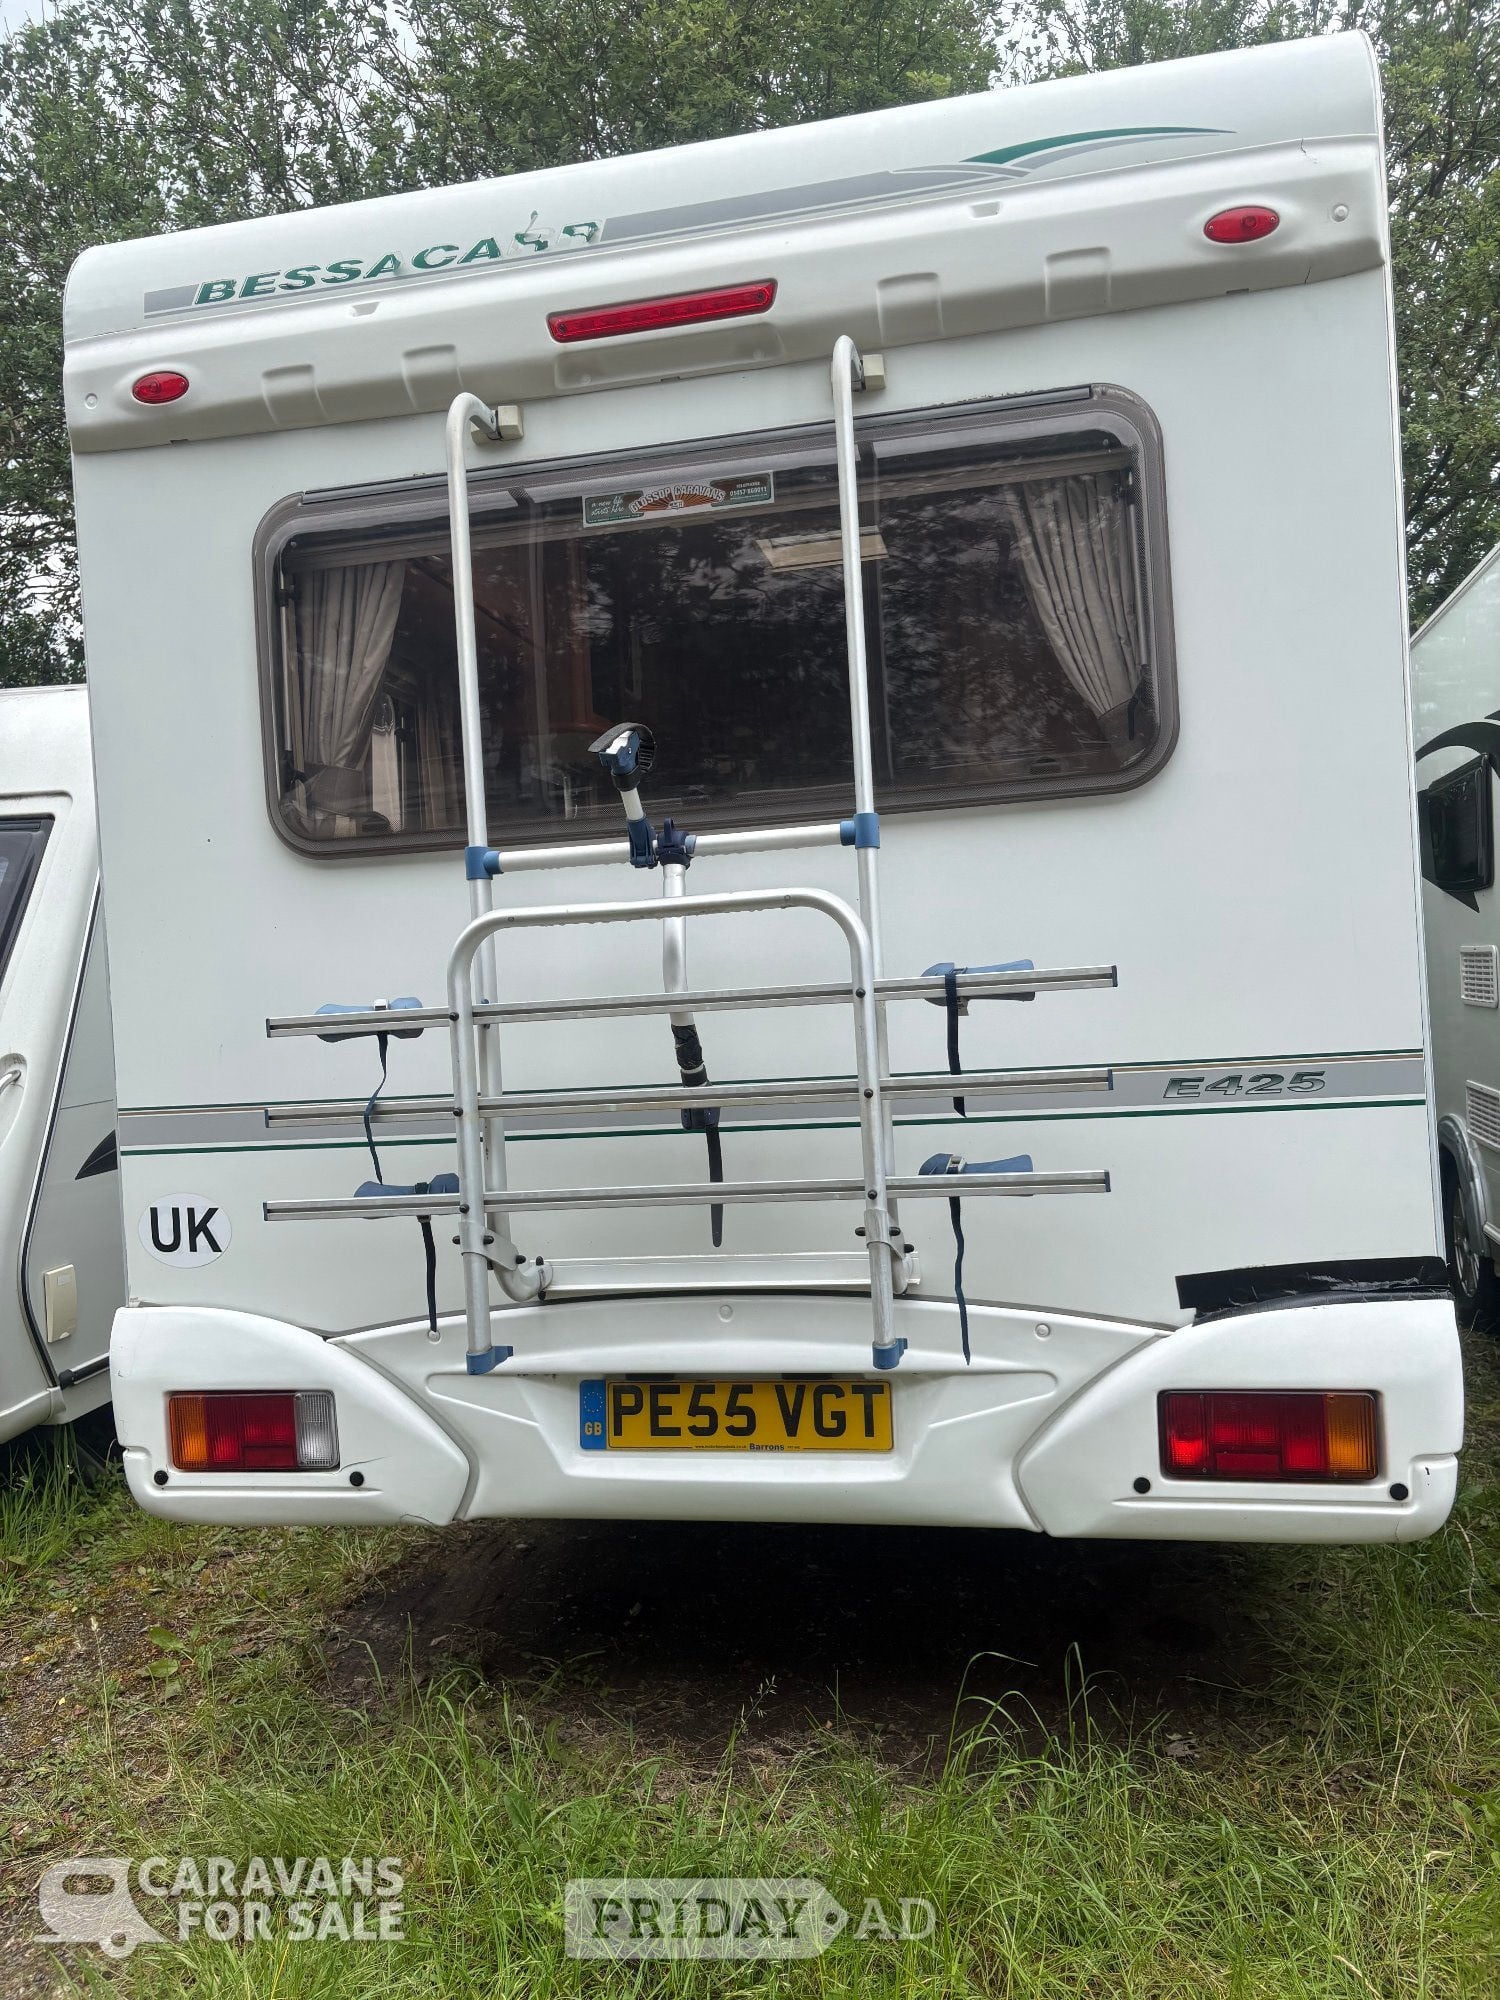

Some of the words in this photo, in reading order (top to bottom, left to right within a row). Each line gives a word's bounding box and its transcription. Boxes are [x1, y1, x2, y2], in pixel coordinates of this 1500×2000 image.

[629, 486, 672, 513] GLOSSOP
[673, 484, 726, 503] CARAVANS
[1163, 1070, 1326, 1099] E425
[150, 1207, 222, 1252] UK
[613, 1384, 756, 1437] PE55
[774, 1384, 884, 1437] VGT
[584, 1421, 602, 1436] GB
[749, 1442, 784, 1451] Barrons
